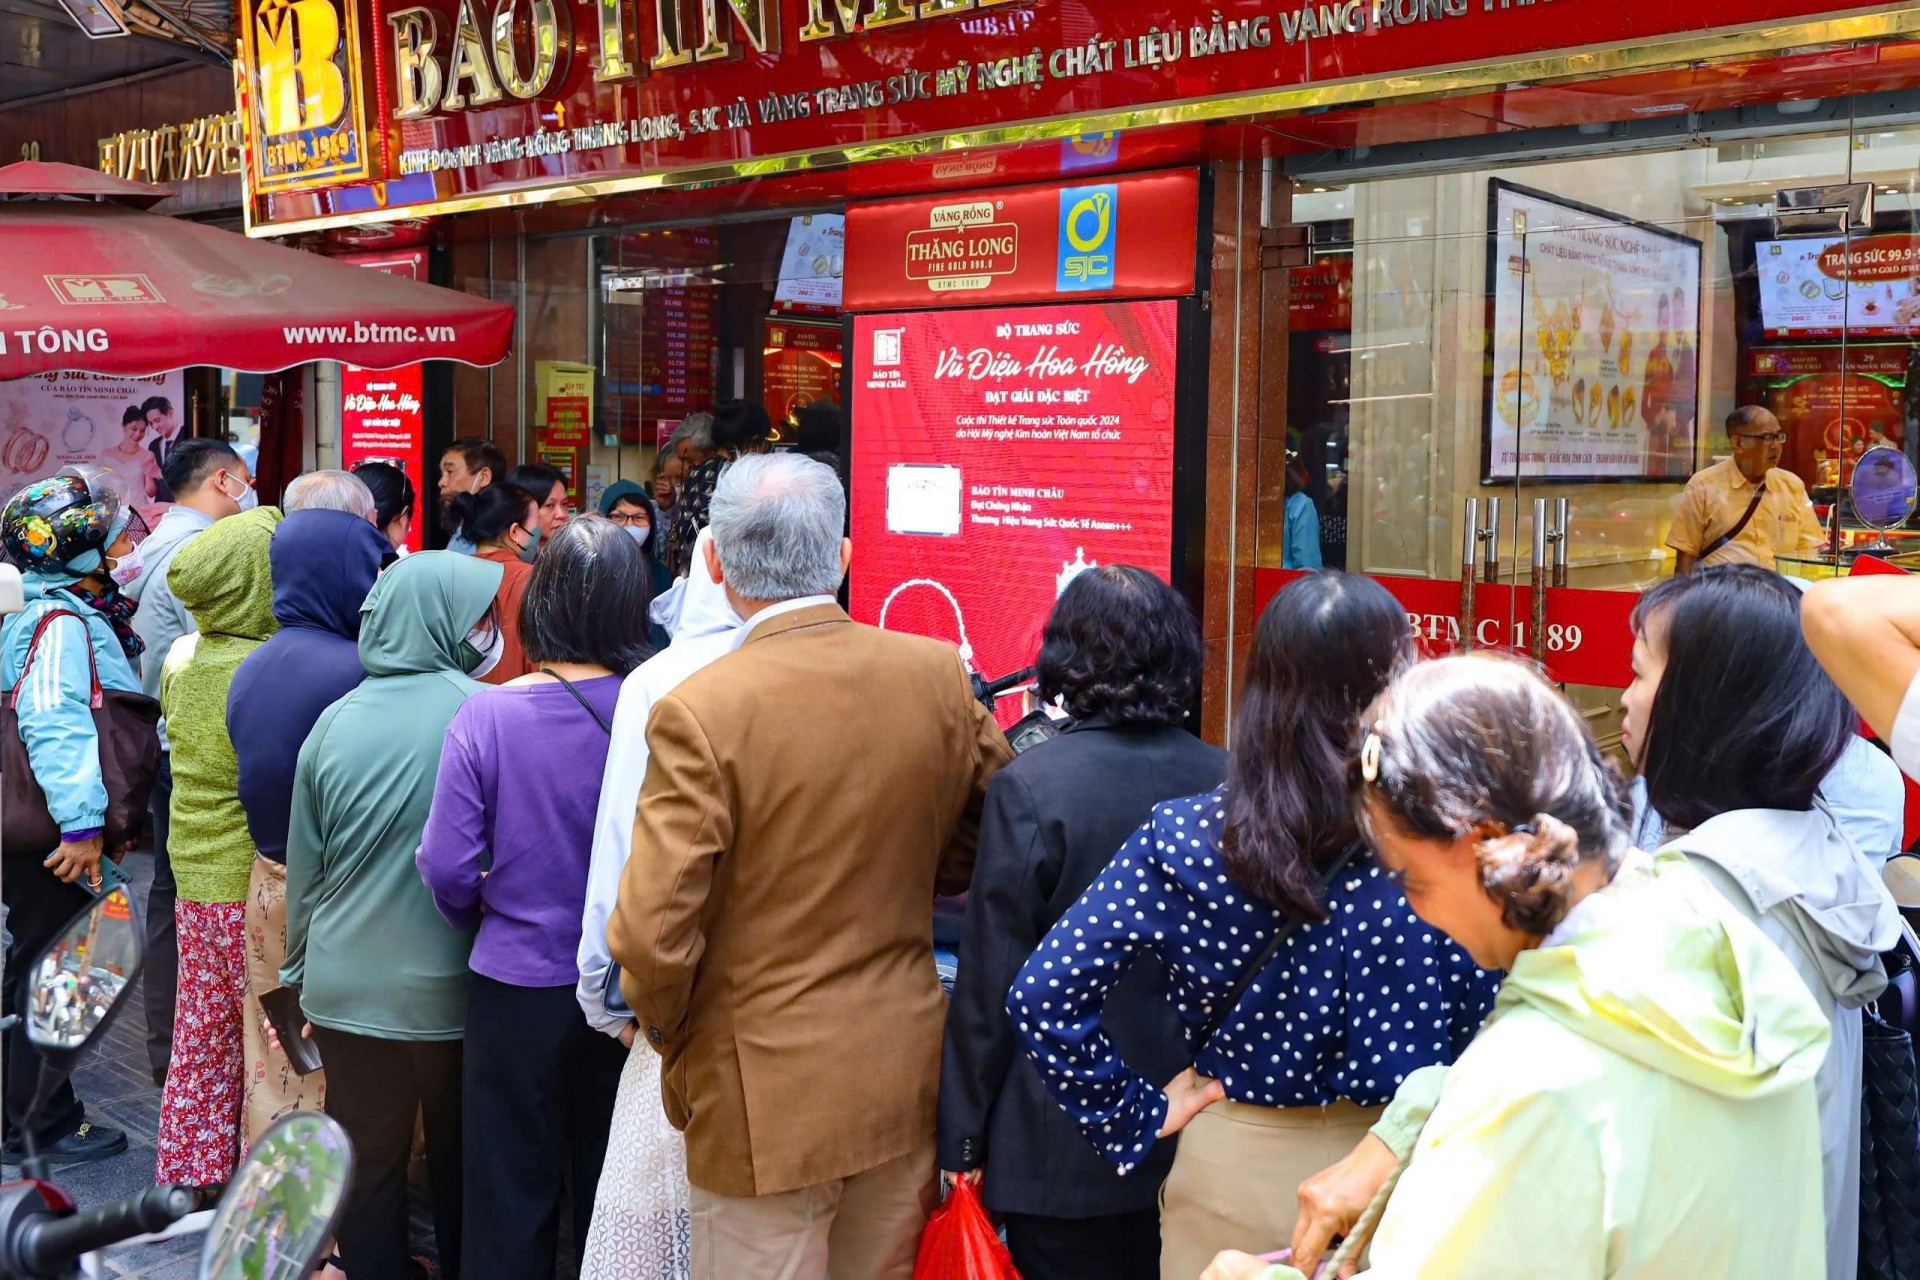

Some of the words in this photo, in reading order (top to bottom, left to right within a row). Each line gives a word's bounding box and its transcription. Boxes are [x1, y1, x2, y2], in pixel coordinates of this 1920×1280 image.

[398, 148, 430, 176] KINH
[483, 136, 523, 164] VÀNG
[525, 126, 570, 158] RỒNG
[572, 119, 628, 150] THĂNG
[631, 113, 685, 142] LONG,
[689, 106, 721, 134] SJC
[725, 96, 752, 129] VÀ
[758, 91, 811, 124] VÀNG
[813, 80, 884, 116] TRANG
[887, 67, 932, 105] SỨC
[935, 60, 972, 97] MỸ
[977, 47, 1044, 91] NGHỆ
[1049, 32, 1117, 79] CHẤT
[1124, 26, 1182, 71] LIỆU
[1189, 9, 1271, 58] BẰNG
[311, 131, 350, 160] 1989
[933, 209, 961, 223] VÀNG
[963, 204, 992, 221] RỒNG
[909, 238, 964, 261] THĂNG
[968, 236, 1014, 256] LONG
[1825, 252, 1862, 267] TRANG
[1864, 247, 1886, 263] SỨC
[928, 262, 945, 272] FINE
[948, 261, 967, 271] GOLD
[970, 259, 993, 269] 999.9
[1878, 266, 1900, 274] GOLD
[14, 325, 109, 354] TÔNG
[283, 320, 456, 344] www.btmc.vn
[996, 325, 1011, 340] BỘ
[1014, 324, 1053, 337] TRANG
[1055, 320, 1080, 336] SỨC
[934, 346, 964, 380] Vũ
[967, 347, 1024, 383] Điệu
[1025, 345, 1078, 379] Hoa
[1080, 343, 1149, 384] Hồng
[1863, 354, 1874, 362] 29
[985, 391, 1009, 405] ĐẠT
[1010, 389, 1034, 403] GIẢI
[1036, 389, 1060, 404] ĐẶC
[1063, 388, 1091, 405] BIỆT
[976, 415, 987, 425] thi
[1018, 416, 1041, 427] Trang
[1056, 416, 1077, 426] Toàn
[1099, 416, 1120, 426] 2024
[956, 428, 966, 438] do
[1014, 429, 1031, 438] Kim
[1070, 430, 1090, 440] Nam
[971, 485, 991, 496] BẢO
[992, 485, 1008, 497] TÍN
[1009, 487, 1035, 498] MINH
[1036, 486, 1065, 499] CHÂU
[1513, 621, 1583, 652] 189
